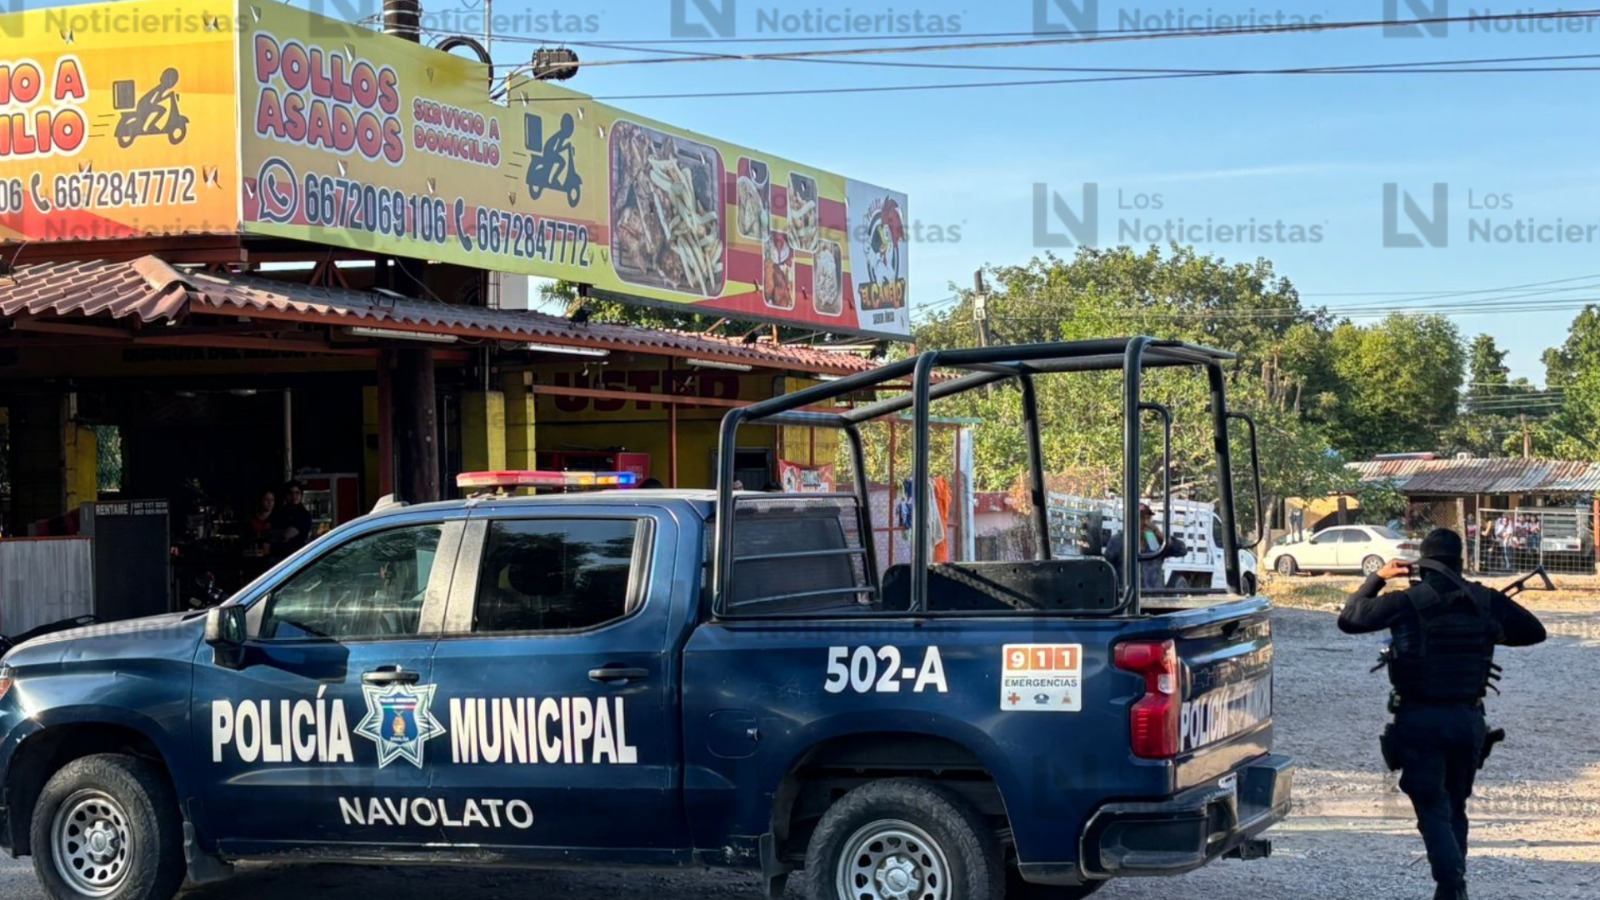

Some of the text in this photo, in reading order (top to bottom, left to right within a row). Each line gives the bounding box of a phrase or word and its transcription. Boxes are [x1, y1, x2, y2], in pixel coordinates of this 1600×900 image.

[55, 58, 85, 100] A
[254, 34, 399, 115] POLLOS
[256, 87, 404, 163] ASADOS
[413, 98, 500, 140] SERVICIO A
[414, 124, 500, 166] DOMICILIO
[54, 168, 195, 208] 6672847772
[304, 173, 589, 267] 6672069106 6672847772
[824, 645, 948, 693] 502-A
[1004, 678, 1078, 688] EMERGENCIAS
[211, 684, 638, 764] POLICÍA MUNICIPAL
[338, 796, 535, 829] NAVOLATO
